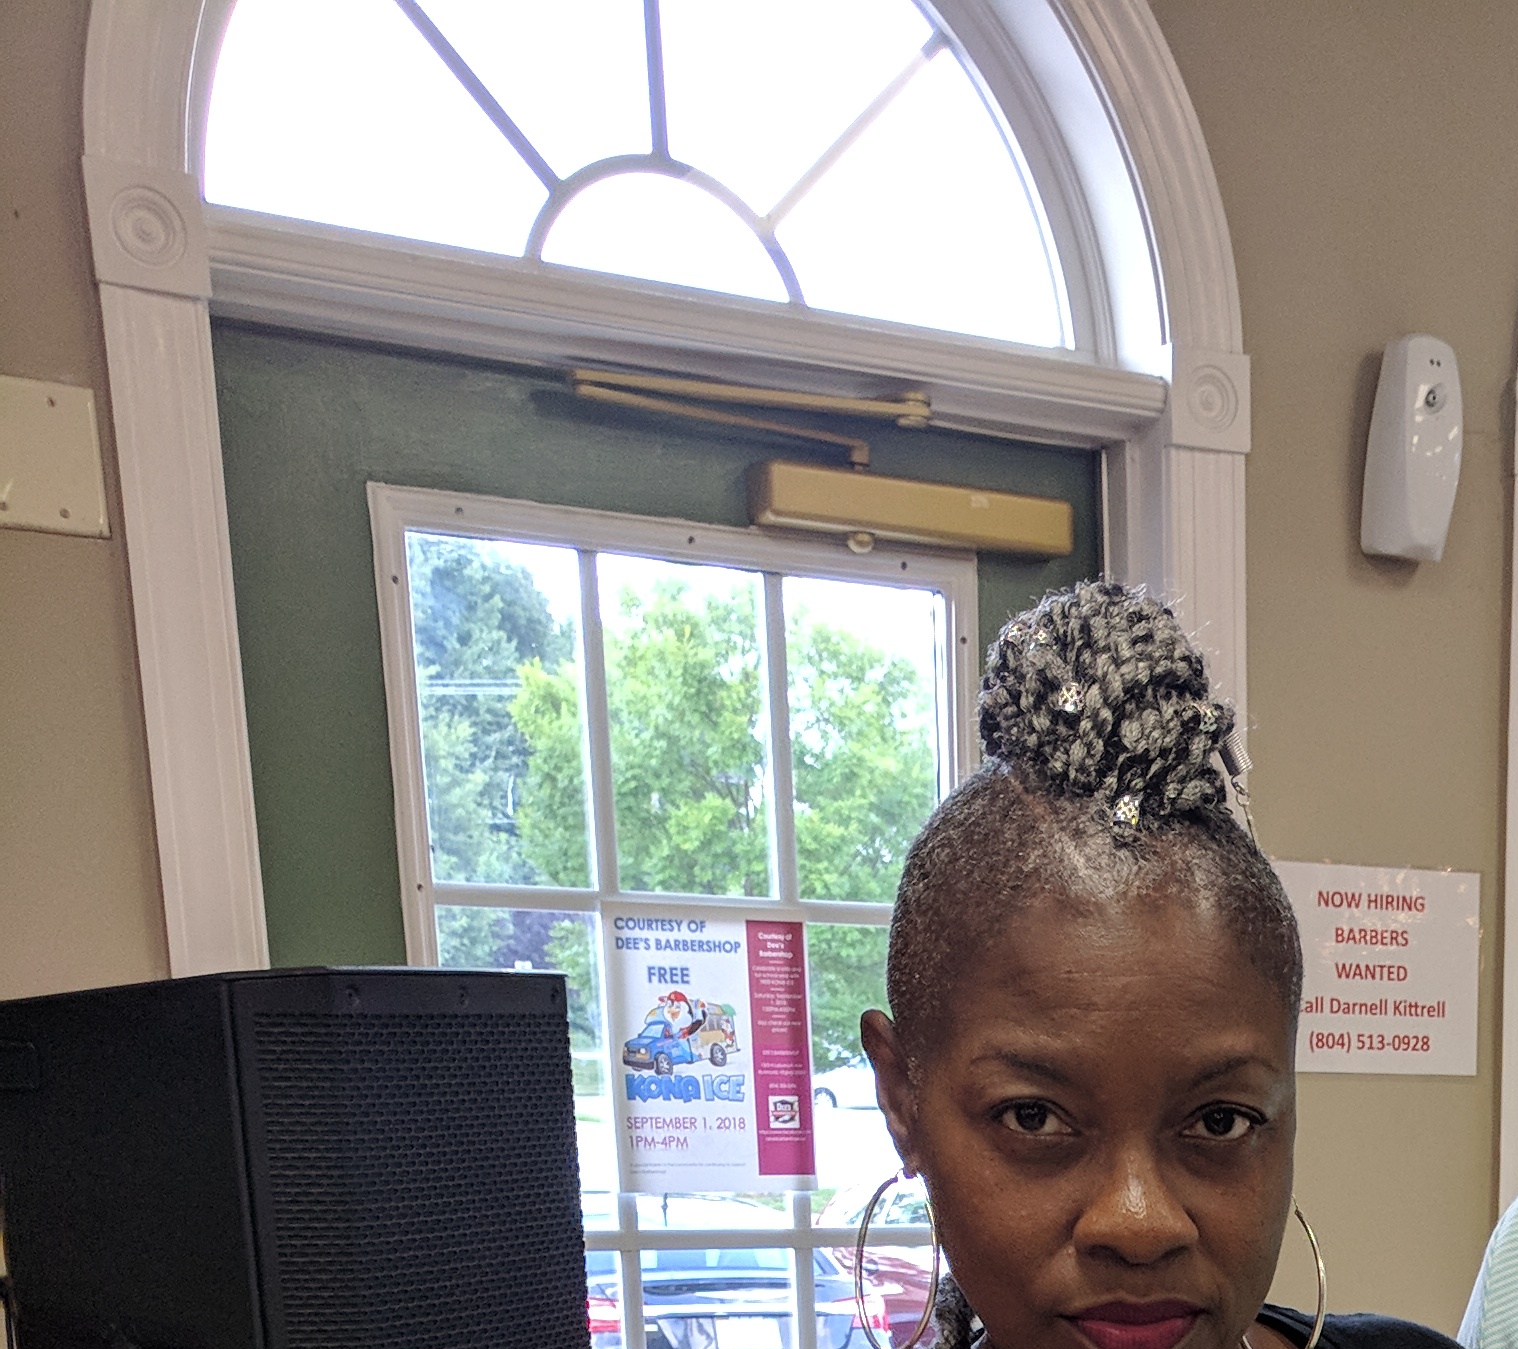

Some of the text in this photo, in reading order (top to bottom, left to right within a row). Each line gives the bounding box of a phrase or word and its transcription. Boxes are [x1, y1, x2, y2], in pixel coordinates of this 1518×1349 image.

[1317, 890, 1426, 912] NOW HIRING
[614, 917, 706, 933] COURTESY OF
[615, 937, 742, 954] DEE'S BARBERSHOP
[1335, 927, 1409, 947] BARBERS
[647, 966, 690, 985] FREE
[1335, 963, 1408, 982] WANTED
[1300, 997, 1446, 1018] all Darnell Kittrell
[1309, 1031, 1430, 1053] (804) 513-0928
[625, 1073, 745, 1103] KONA ICE
[626, 1116, 698, 1130] SEPTEMBER
[716, 1117, 746, 1130] 2018
[629, 1135, 689, 1150] 1PM-4PM
